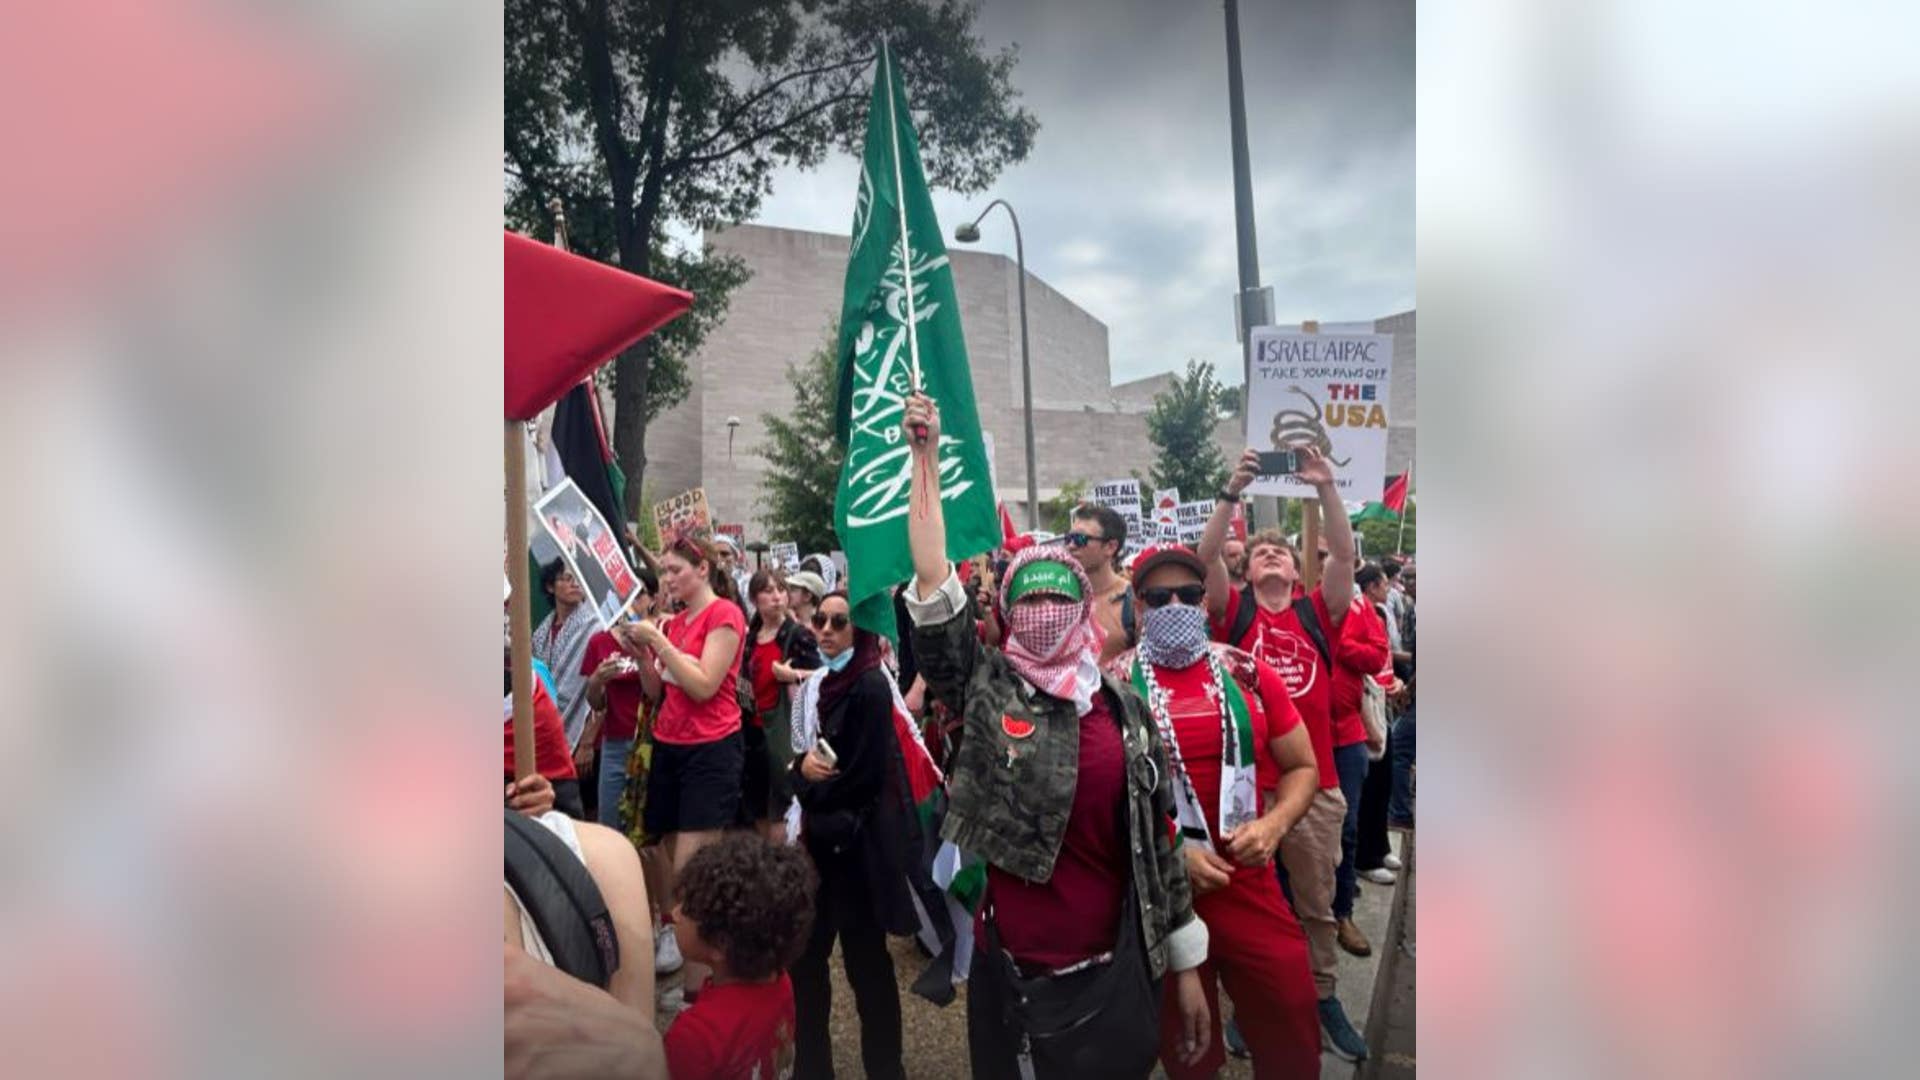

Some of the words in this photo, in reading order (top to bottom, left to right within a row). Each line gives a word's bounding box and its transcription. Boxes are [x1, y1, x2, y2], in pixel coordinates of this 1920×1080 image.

[1259, 366, 1299, 380] TAKE
[1303, 367, 1332, 380] YOUR
[1332, 367, 1364, 380] PAWS
[1365, 368, 1388, 381] OFF
[1327, 384, 1377, 401] THE
[1324, 404, 1388, 429] USA
[1095, 485, 1119, 497] FREE
[1119, 484, 1137, 496] ALL
[656, 490, 703, 517] BLOOD
[1177, 507, 1198, 518] FREE
